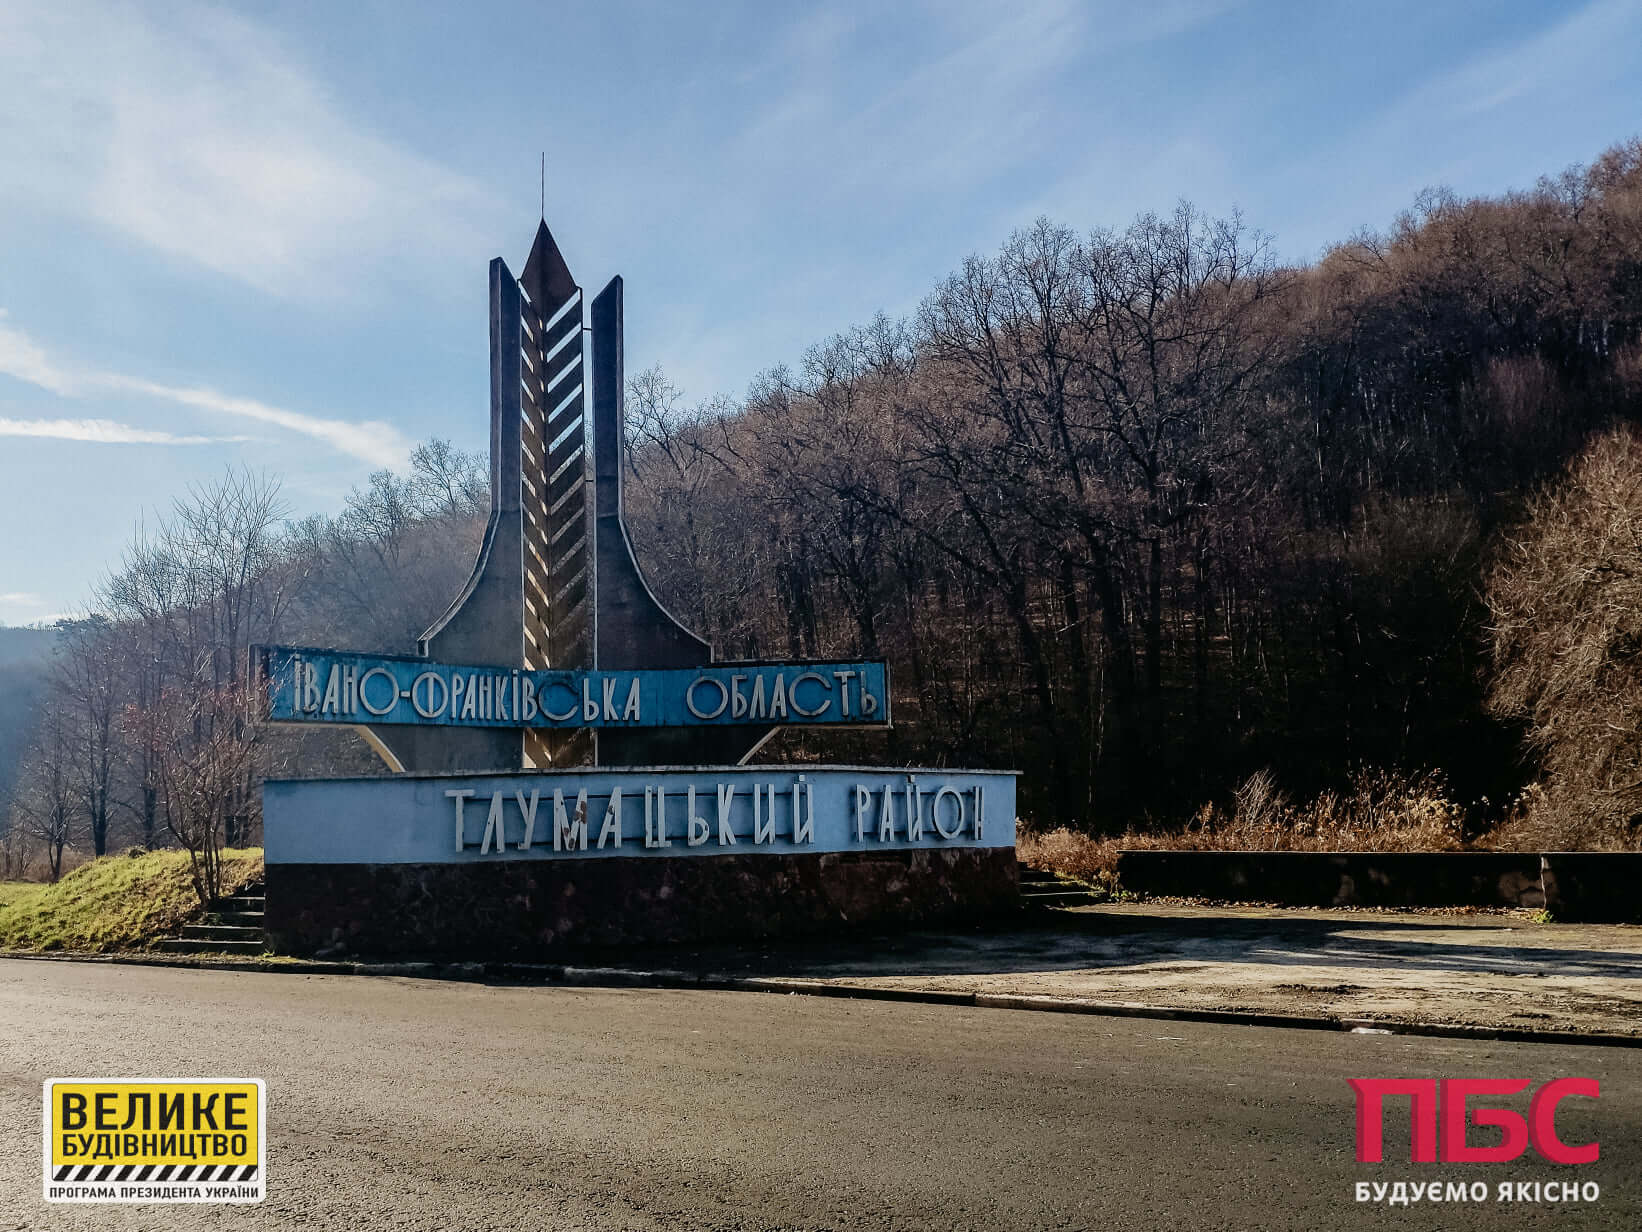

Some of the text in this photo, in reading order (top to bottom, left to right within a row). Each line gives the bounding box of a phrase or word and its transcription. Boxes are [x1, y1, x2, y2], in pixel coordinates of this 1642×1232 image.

[294, 654, 878, 722] ІВАНО-ФРАНКІВСЬКА ОБЛАСТЬ
[444, 774, 985, 856] ТЛУМАЦЬКИЙ РАЙОН
